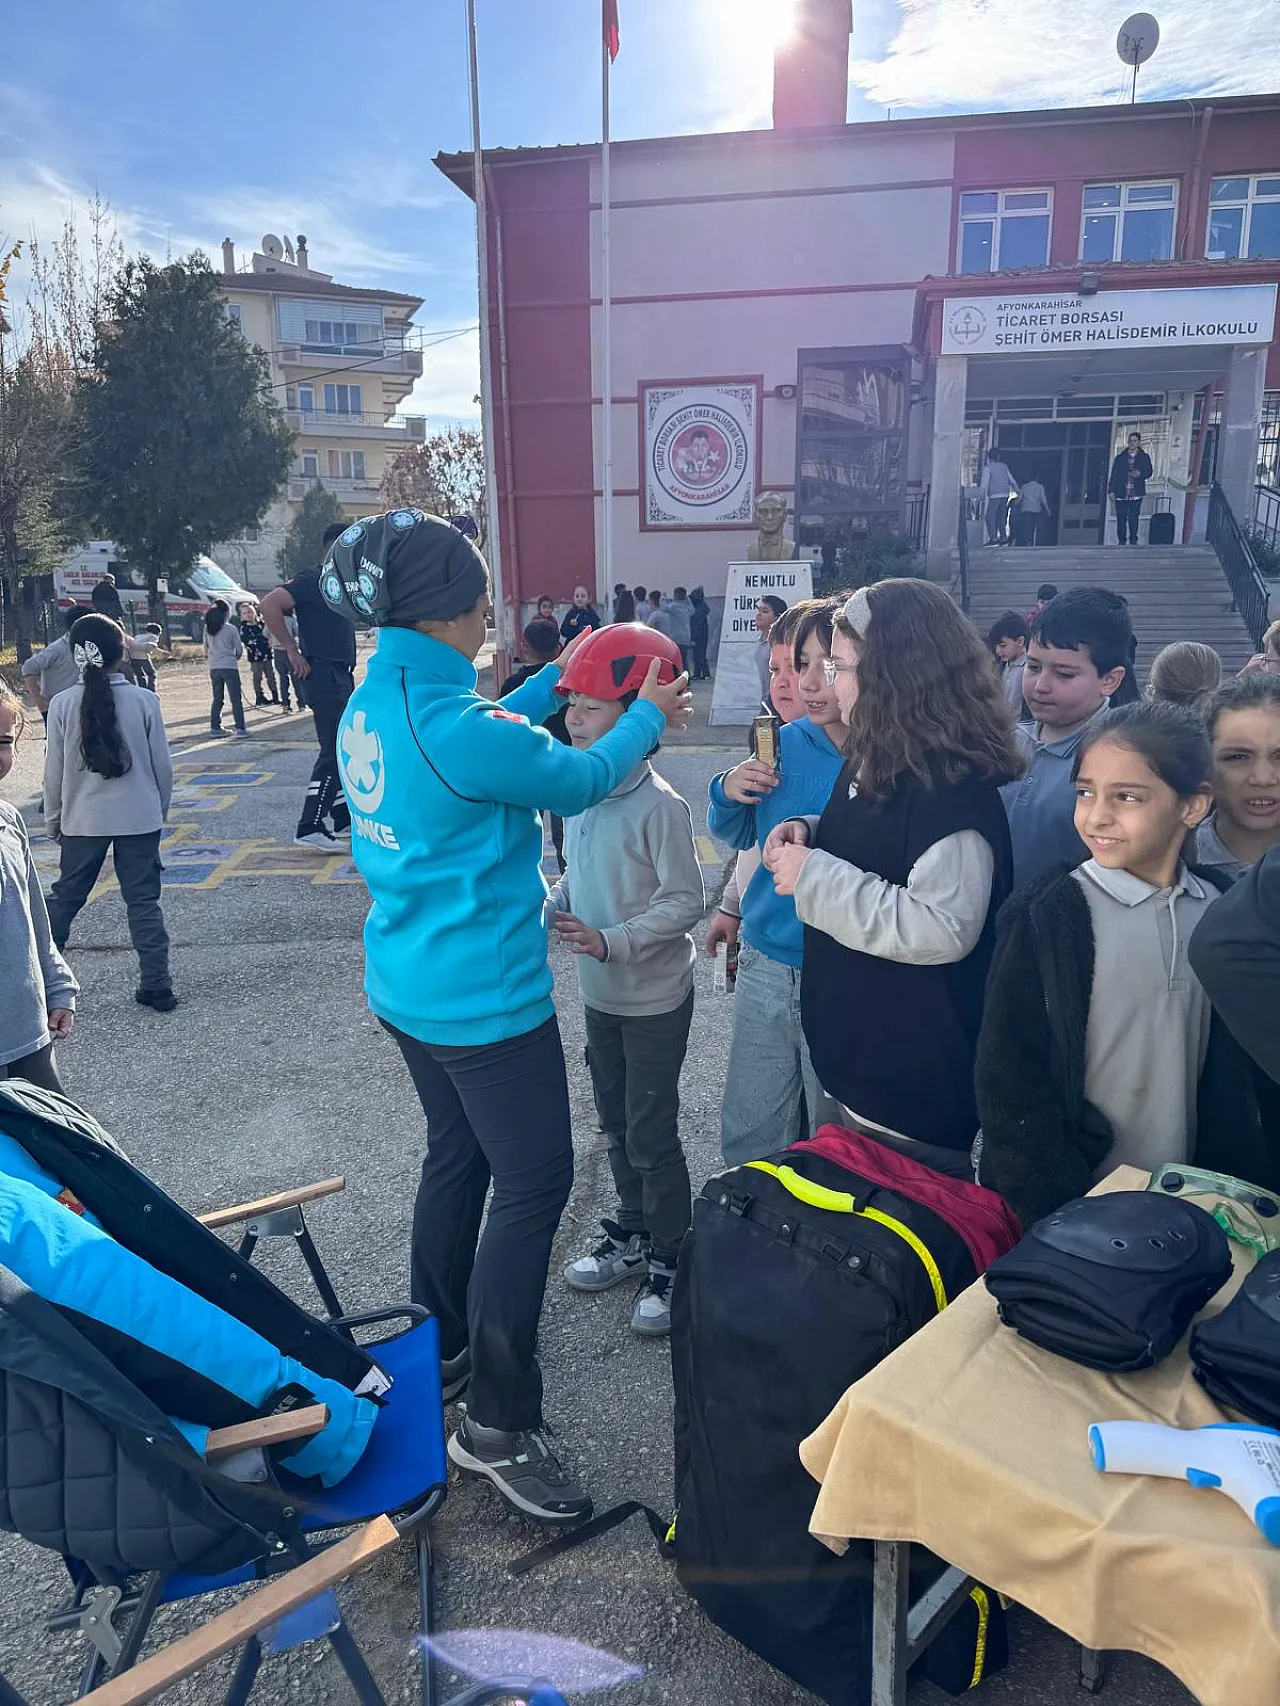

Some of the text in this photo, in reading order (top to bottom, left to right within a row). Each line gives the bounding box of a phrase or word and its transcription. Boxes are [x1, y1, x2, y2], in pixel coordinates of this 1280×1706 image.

[996, 299, 1083, 312] AFYONKARAHİSAR
[996, 310, 1124, 328] TİCARET BORSASI
[995, 322, 1258, 346] ŞEHİT ÖMER HALİSDEMİR İLKOKULU
[745, 574, 796, 588] NE MUTLU
[732, 618, 760, 632] DİYE
